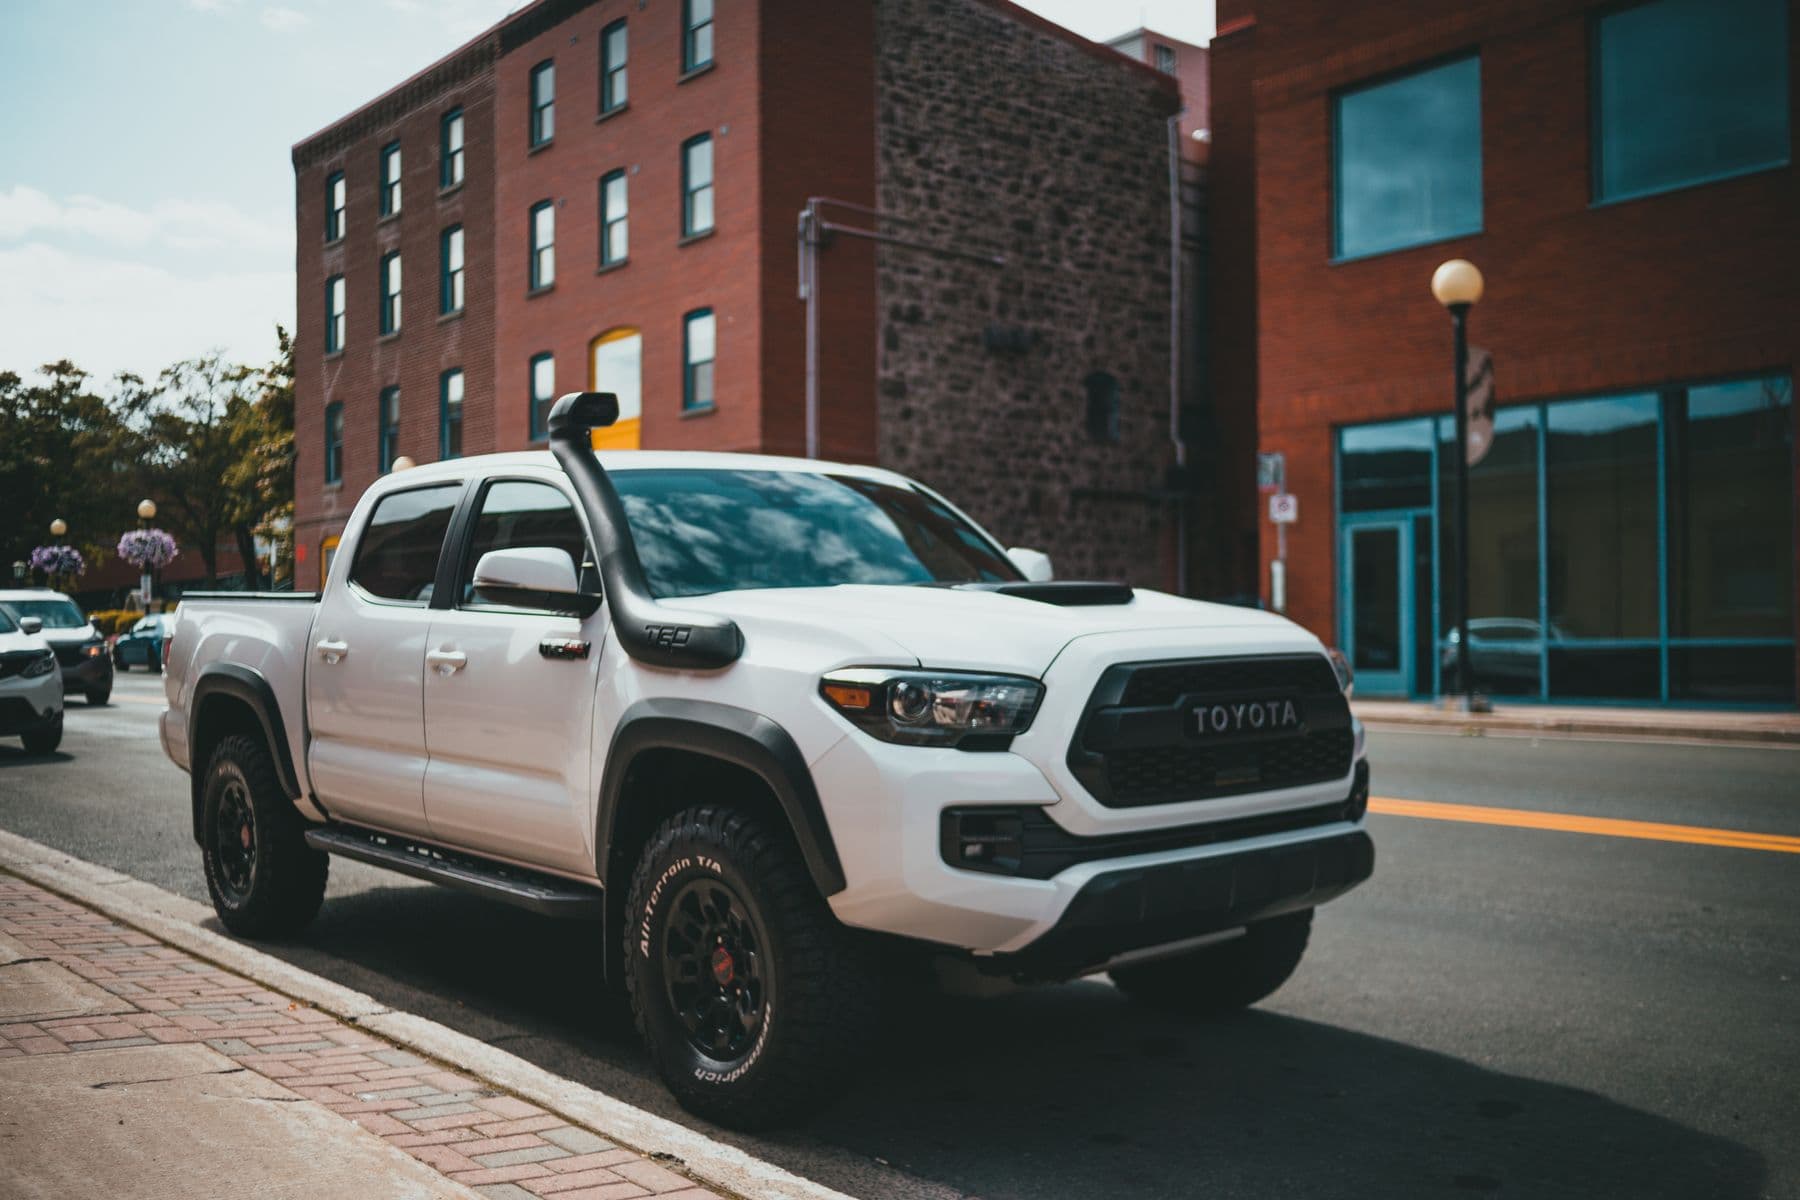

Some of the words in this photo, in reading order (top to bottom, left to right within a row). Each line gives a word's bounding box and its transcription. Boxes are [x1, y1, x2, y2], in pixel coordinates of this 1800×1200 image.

[1192, 700, 1297, 734] TOYOTA
[640, 858, 691, 958] All-Terrain
[696, 855, 722, 874] T/A
